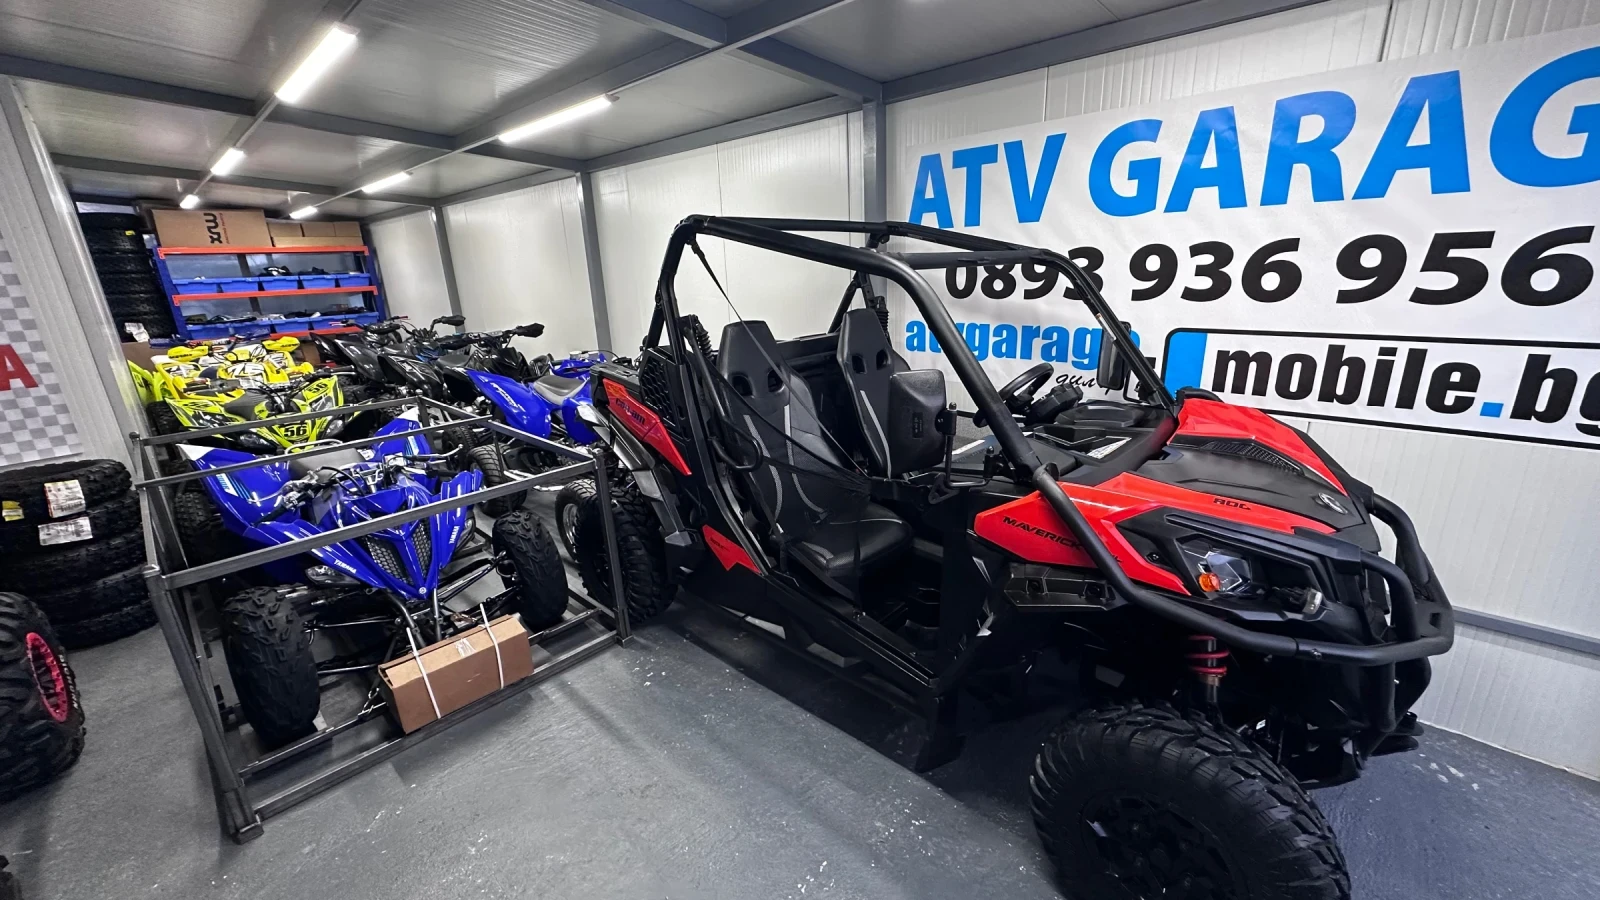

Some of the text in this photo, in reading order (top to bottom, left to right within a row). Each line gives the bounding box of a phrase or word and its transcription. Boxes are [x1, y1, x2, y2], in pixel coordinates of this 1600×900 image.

[908, 46, 1600, 228] ATV GARAG
[945, 226, 1596, 306] 0893 936 956
[284, 425, 308, 437] 56
